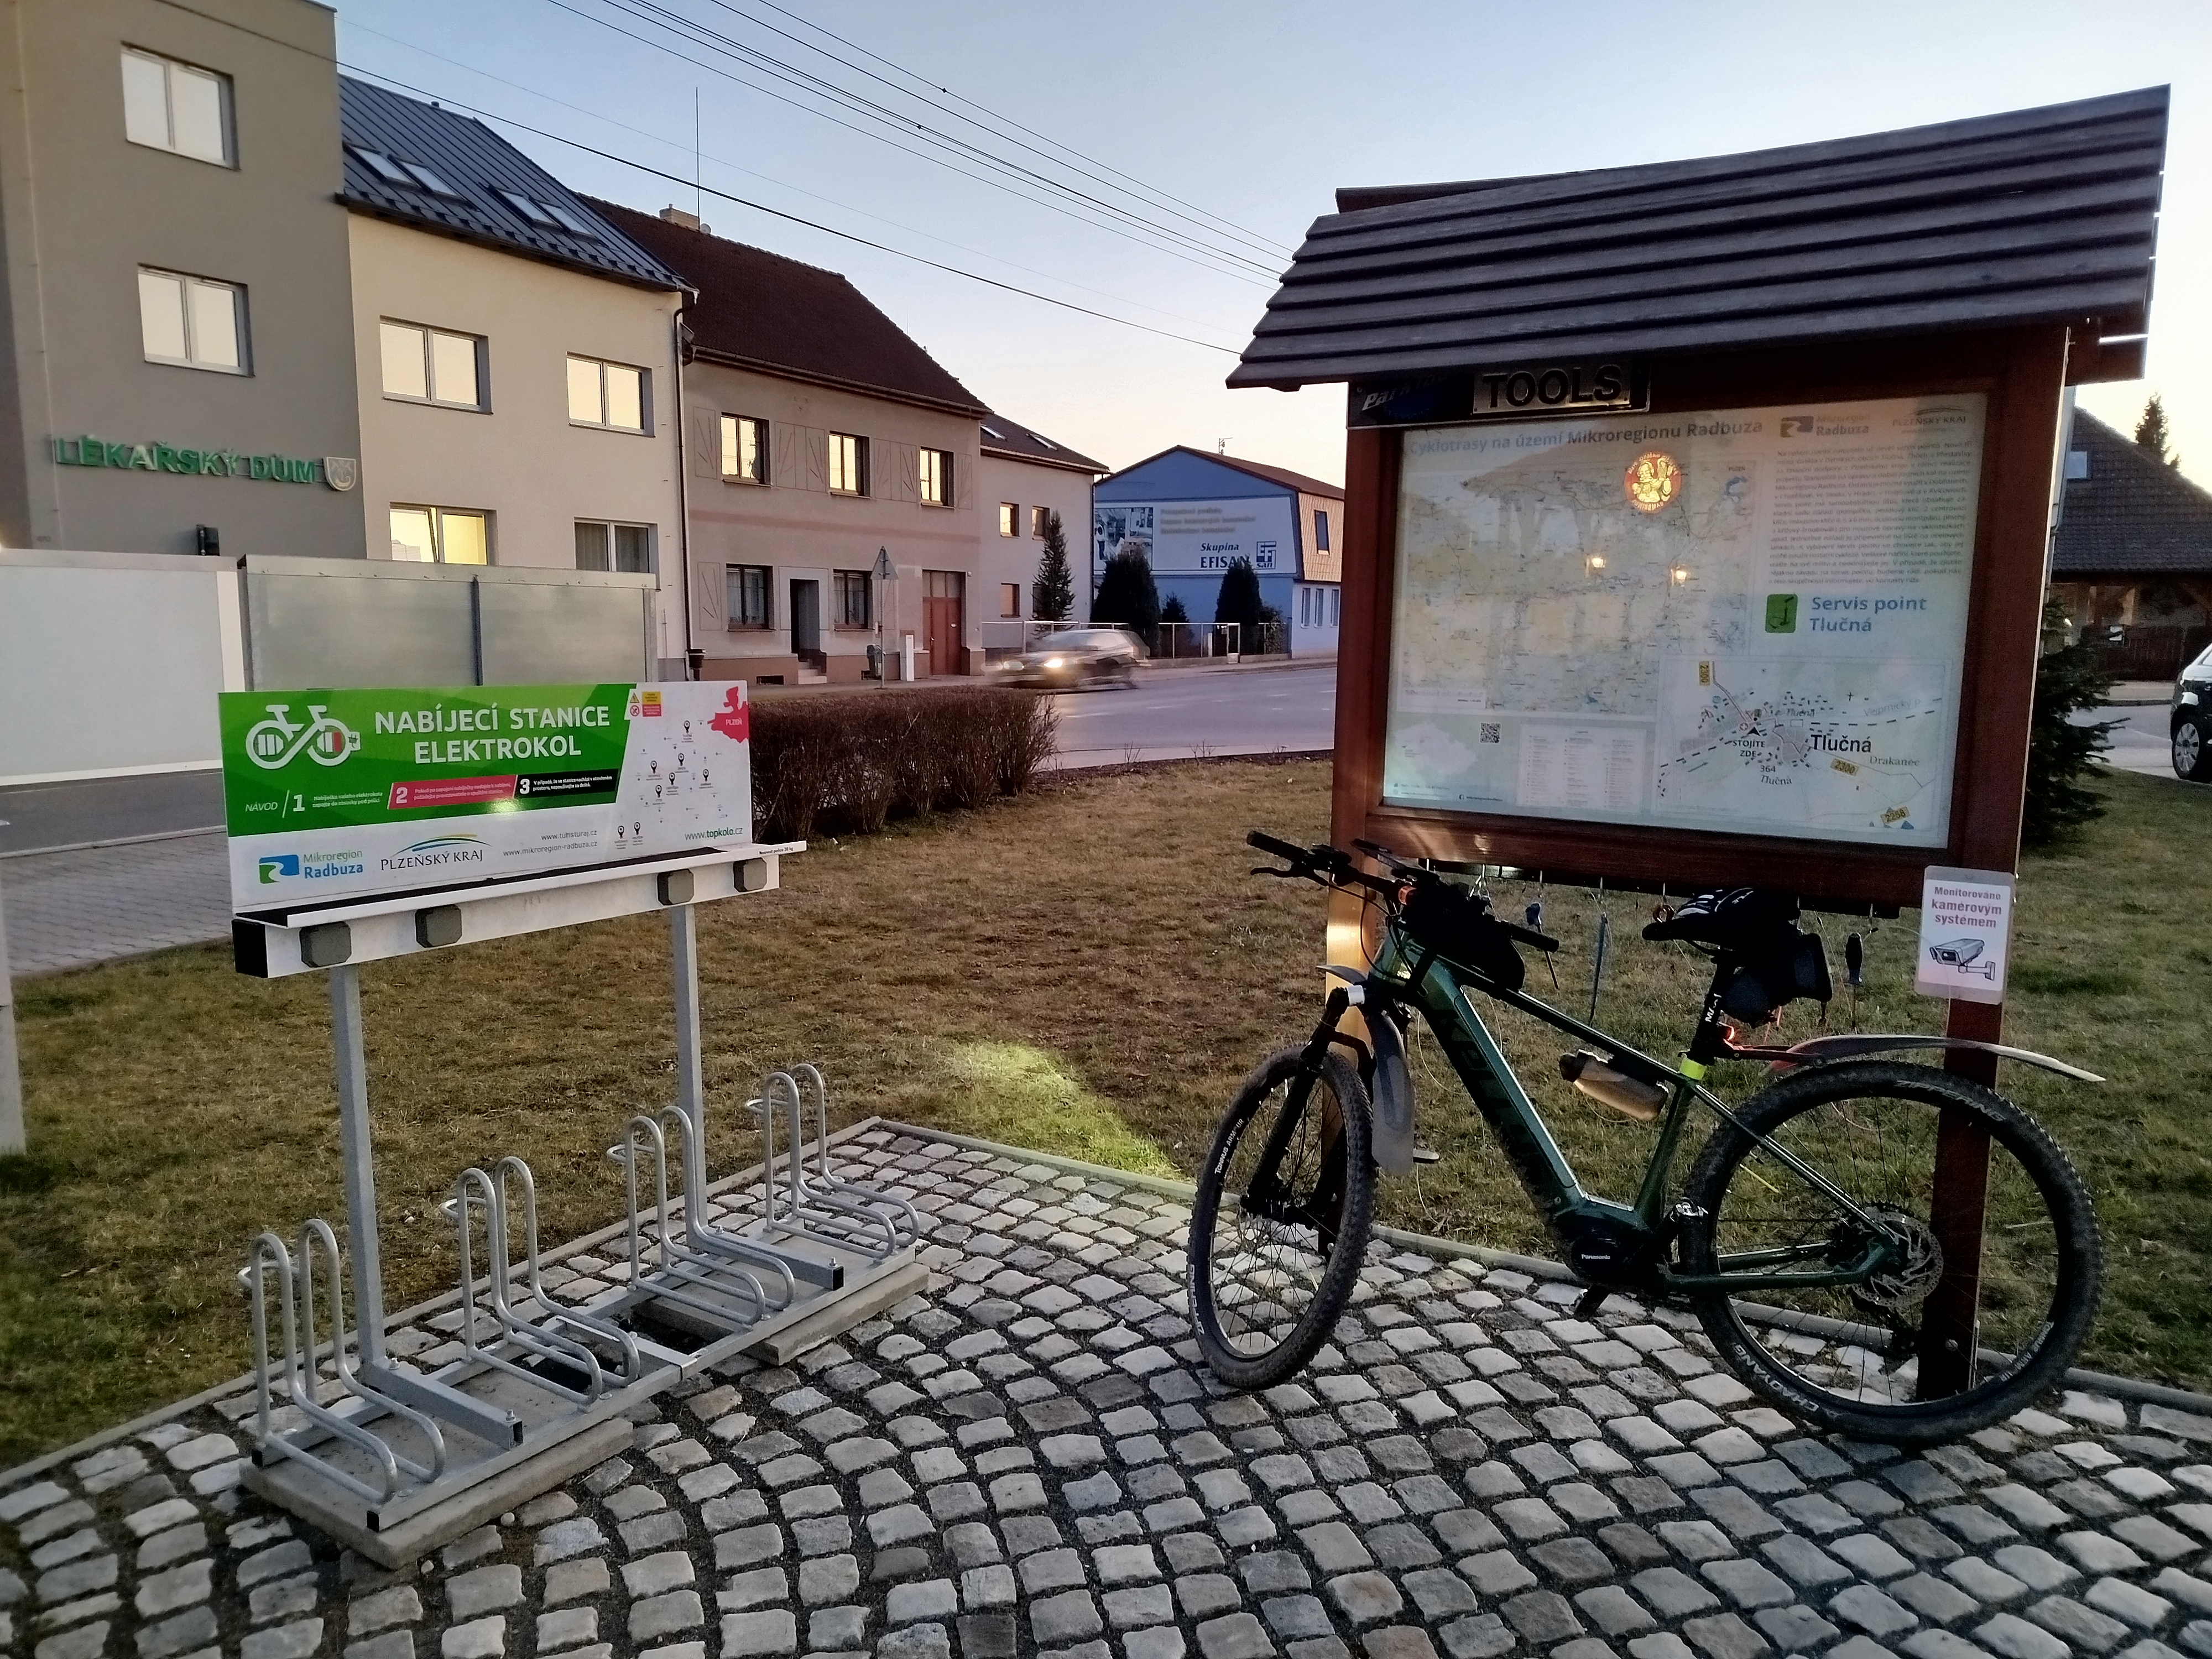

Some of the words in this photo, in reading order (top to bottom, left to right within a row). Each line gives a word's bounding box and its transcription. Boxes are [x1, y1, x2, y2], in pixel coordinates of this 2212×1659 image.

[1483, 364, 1623, 408] TOOLS
[1493, 439, 1510, 448] na
[1567, 423, 1681, 445] Mikroregionu
[1686, 420, 1763, 437] Radbuza
[1816, 424, 1870, 436] Radbuza
[56, 434, 240, 476] LÉKAŘSKÝ
[249, 452, 316, 483] DŮM
[1201, 542, 1239, 553] Skupina
[1812, 596, 1867, 611] Servis
[1875, 596, 1928, 615] point
[1809, 615, 1872, 633] Tlučná
[375, 702, 498, 734] NABÍJECÍ
[510, 706, 611, 730] STANICE
[726, 717, 742, 726] PLZEŇ
[415, 735, 582, 764] ELEKTROKOL
[1810, 734, 1872, 753] Tlučná
[1740, 749, 1757, 758] ZDE
[519, 779, 530, 794] 3
[245, 800, 278, 812] NÁVOD
[293, 794, 305, 812] 1
[395, 787, 408, 804] 2
[685, 826, 743, 842] www.topkolo.cz
[303, 849, 363, 863] Mikroregion
[502, 840, 598, 857] www.mikroregion-radbuza.cz
[380, 851, 450, 871] PLZEŇSKÝ
[453, 849, 484, 863] KRAJ
[304, 862, 363, 879] Radbuza
[1934, 886, 2001, 900] Monitorováno
[1935, 914, 1997, 928] systémem
[1734, 1344, 1819, 1412] CHAOYANG
